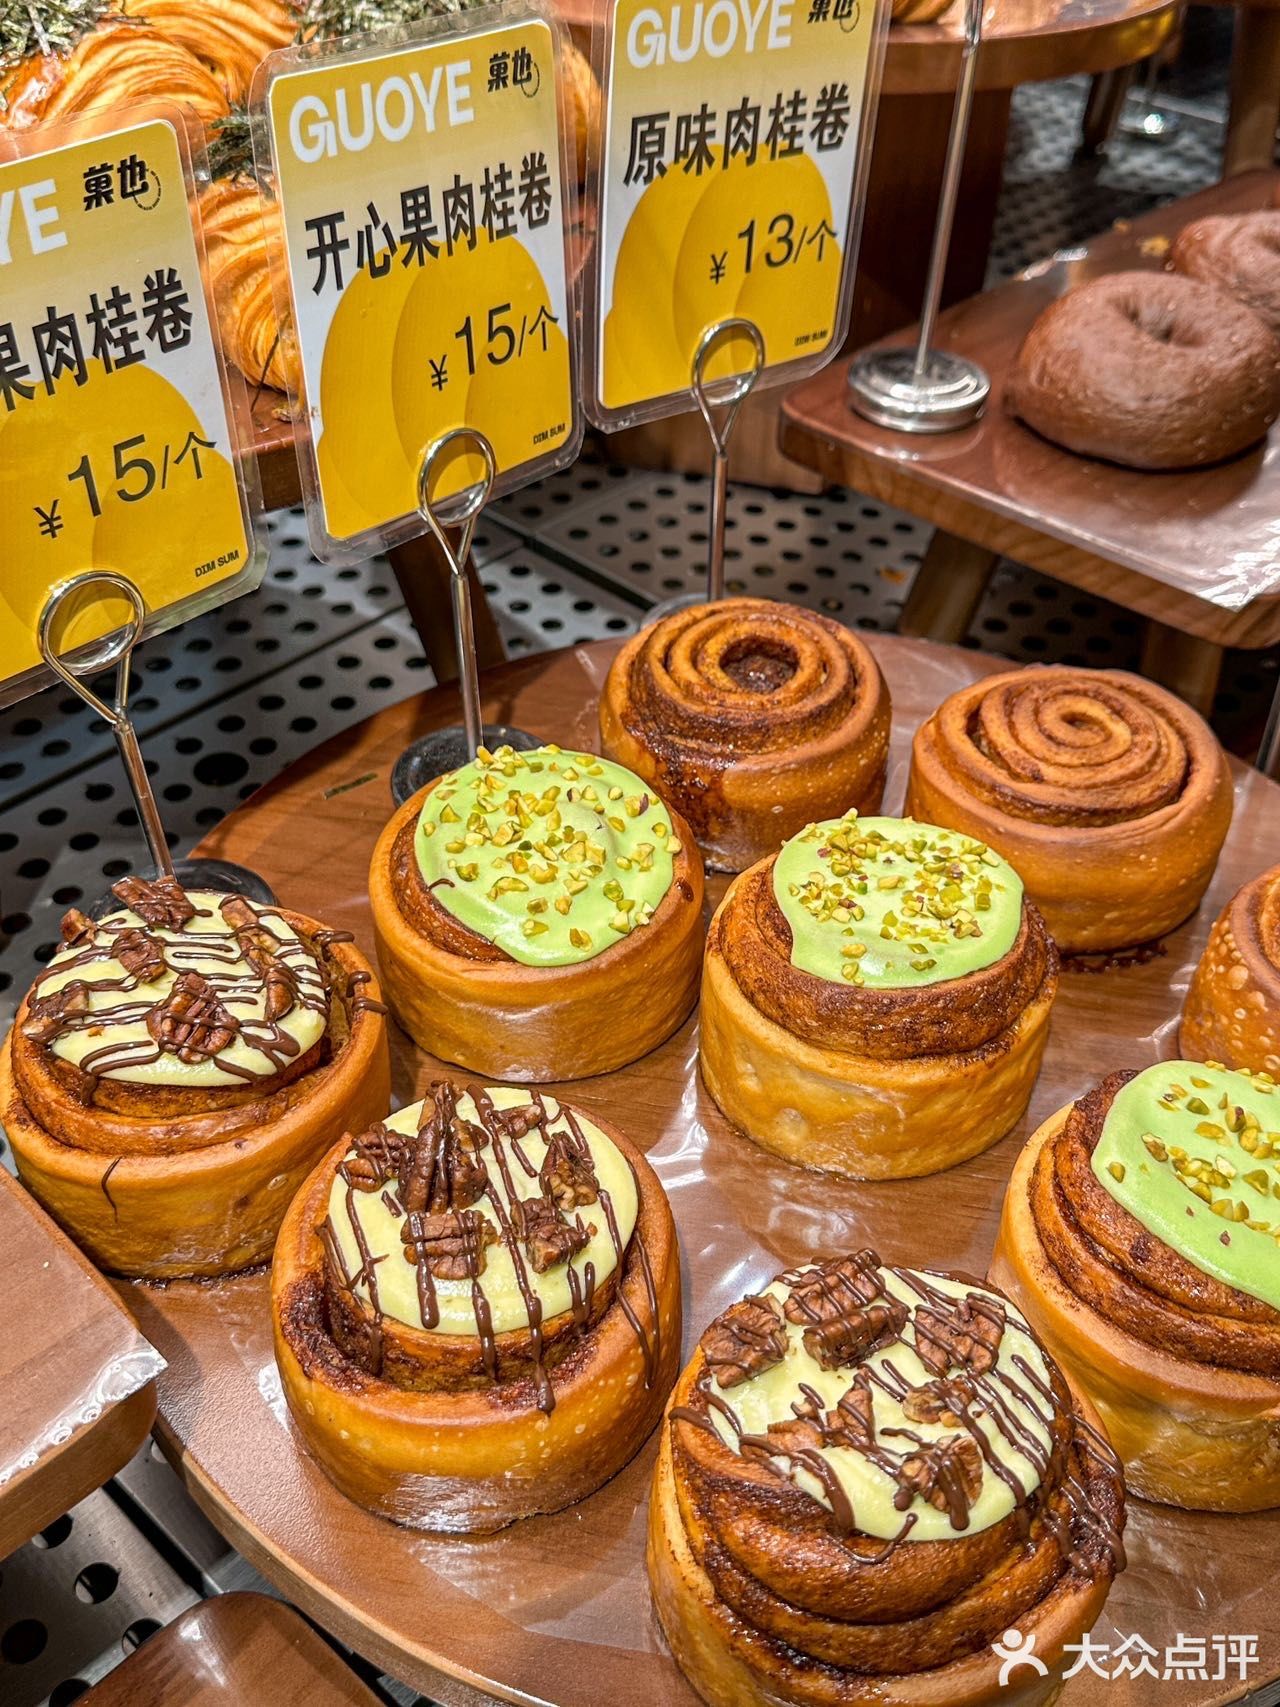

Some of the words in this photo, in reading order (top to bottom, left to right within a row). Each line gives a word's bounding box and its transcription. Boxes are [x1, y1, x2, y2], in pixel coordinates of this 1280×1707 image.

[627, 0, 792, 69] GUOYE
[488, 46, 532, 92] 菓也
[289, 60, 475, 163] GUOYE
[623, 83, 850, 187] 原味肉桂卷
[83, 154, 149, 211] 菓也
[305, 151, 552, 295] 开心果肉桂卷
[533, 430, 548, 444] DIM
[550, 422, 565, 437] SUM
[194, 560, 216, 577] DIM
[217, 549, 239, 566] SUM
